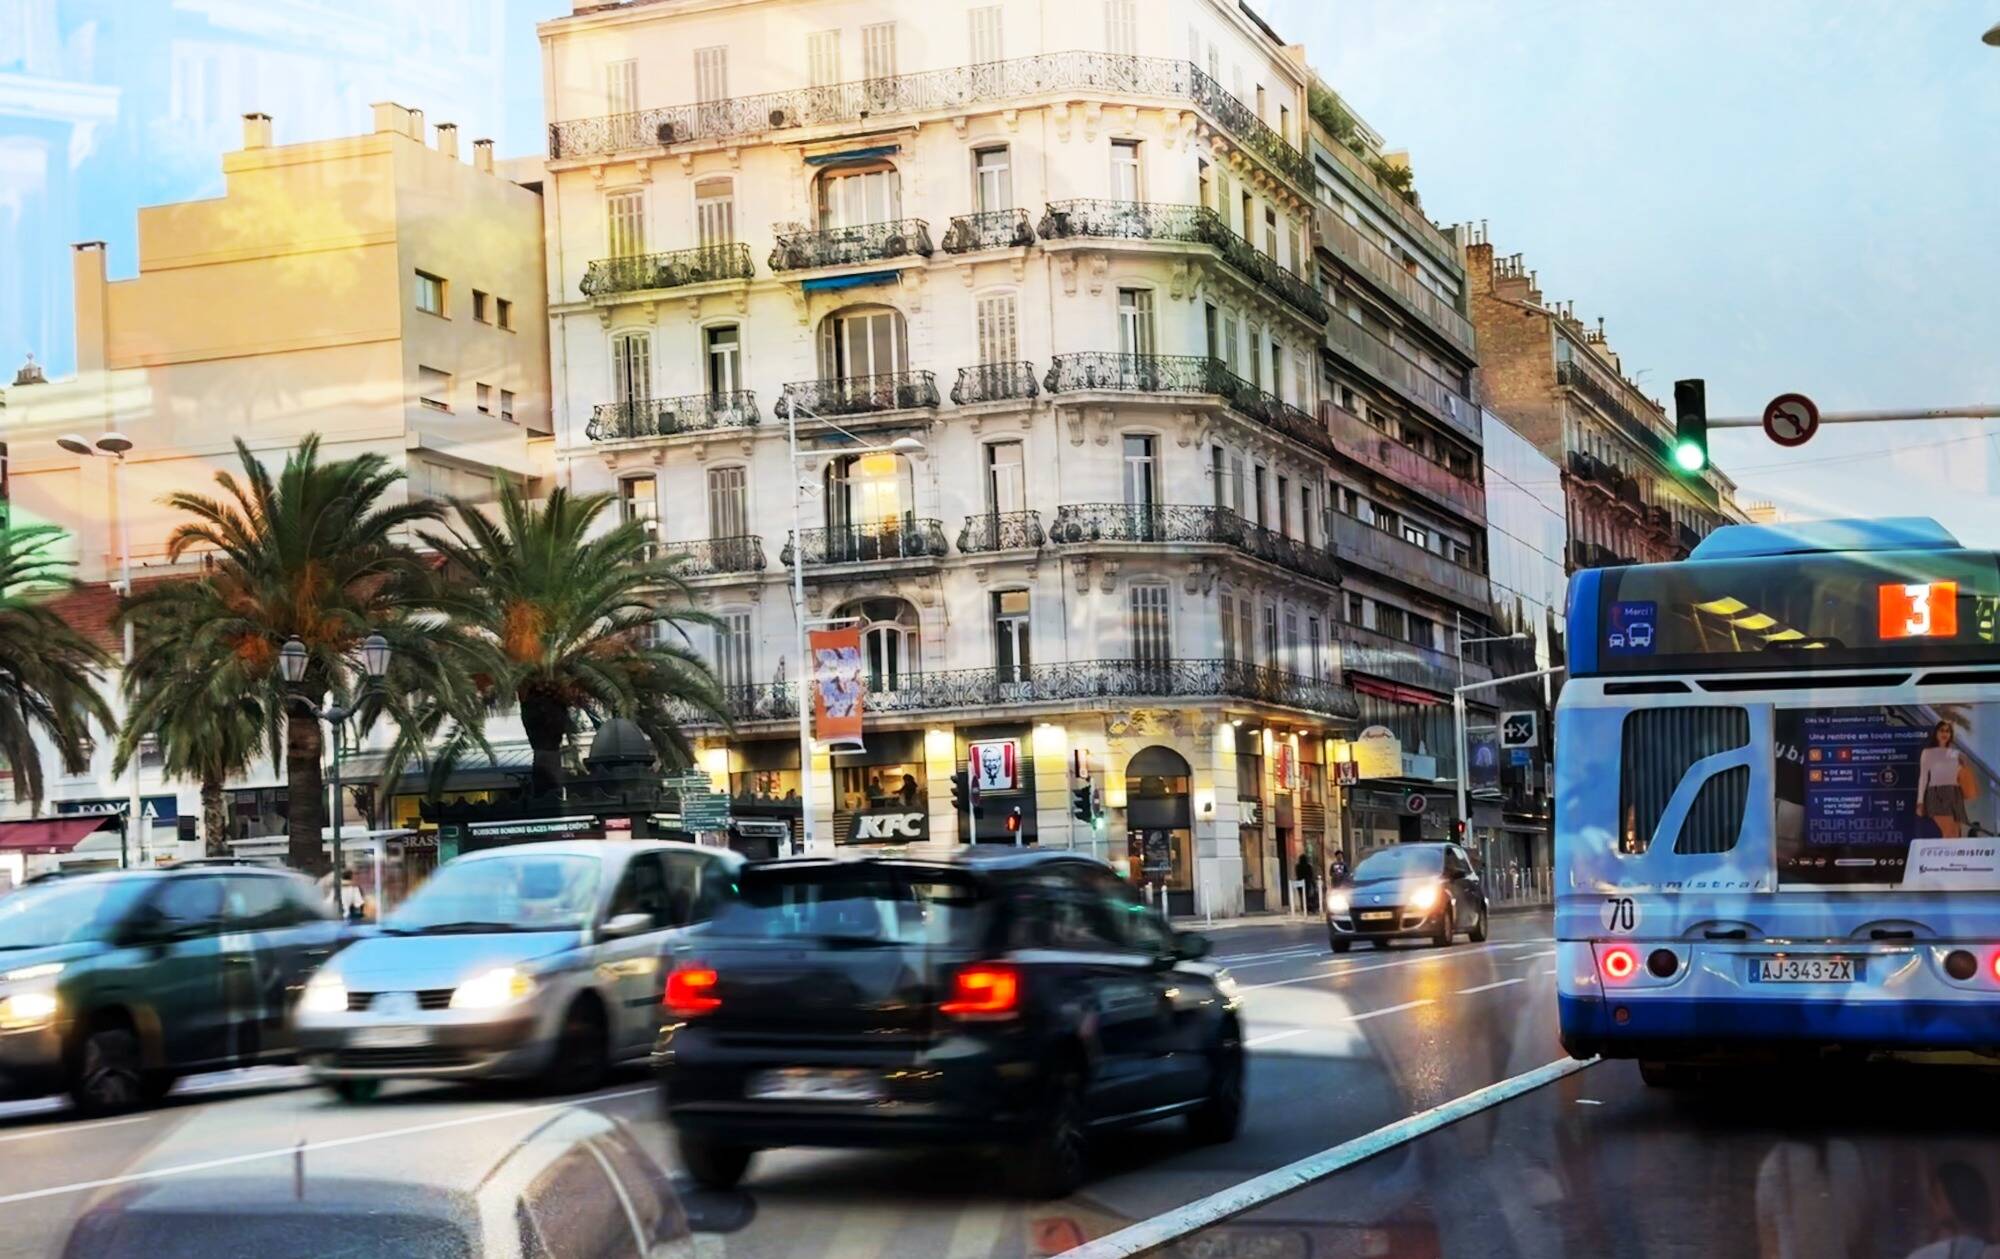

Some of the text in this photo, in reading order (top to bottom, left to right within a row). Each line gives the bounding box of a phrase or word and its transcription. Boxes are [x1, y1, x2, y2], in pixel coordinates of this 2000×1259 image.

[1624, 607, 1648, 616] Merci
[1904, 584, 1931, 636] 3
[1870, 732, 1892, 740] toute
[1894, 731, 1928, 739] mobilité
[856, 812, 925, 839] KFC
[1810, 817, 1895, 831] POUR MIEUX
[1810, 830, 1904, 844] VOUS SERVIR
[1608, 898, 1634, 930] 70
[1761, 961, 1851, 980] AJ-343-ZX
